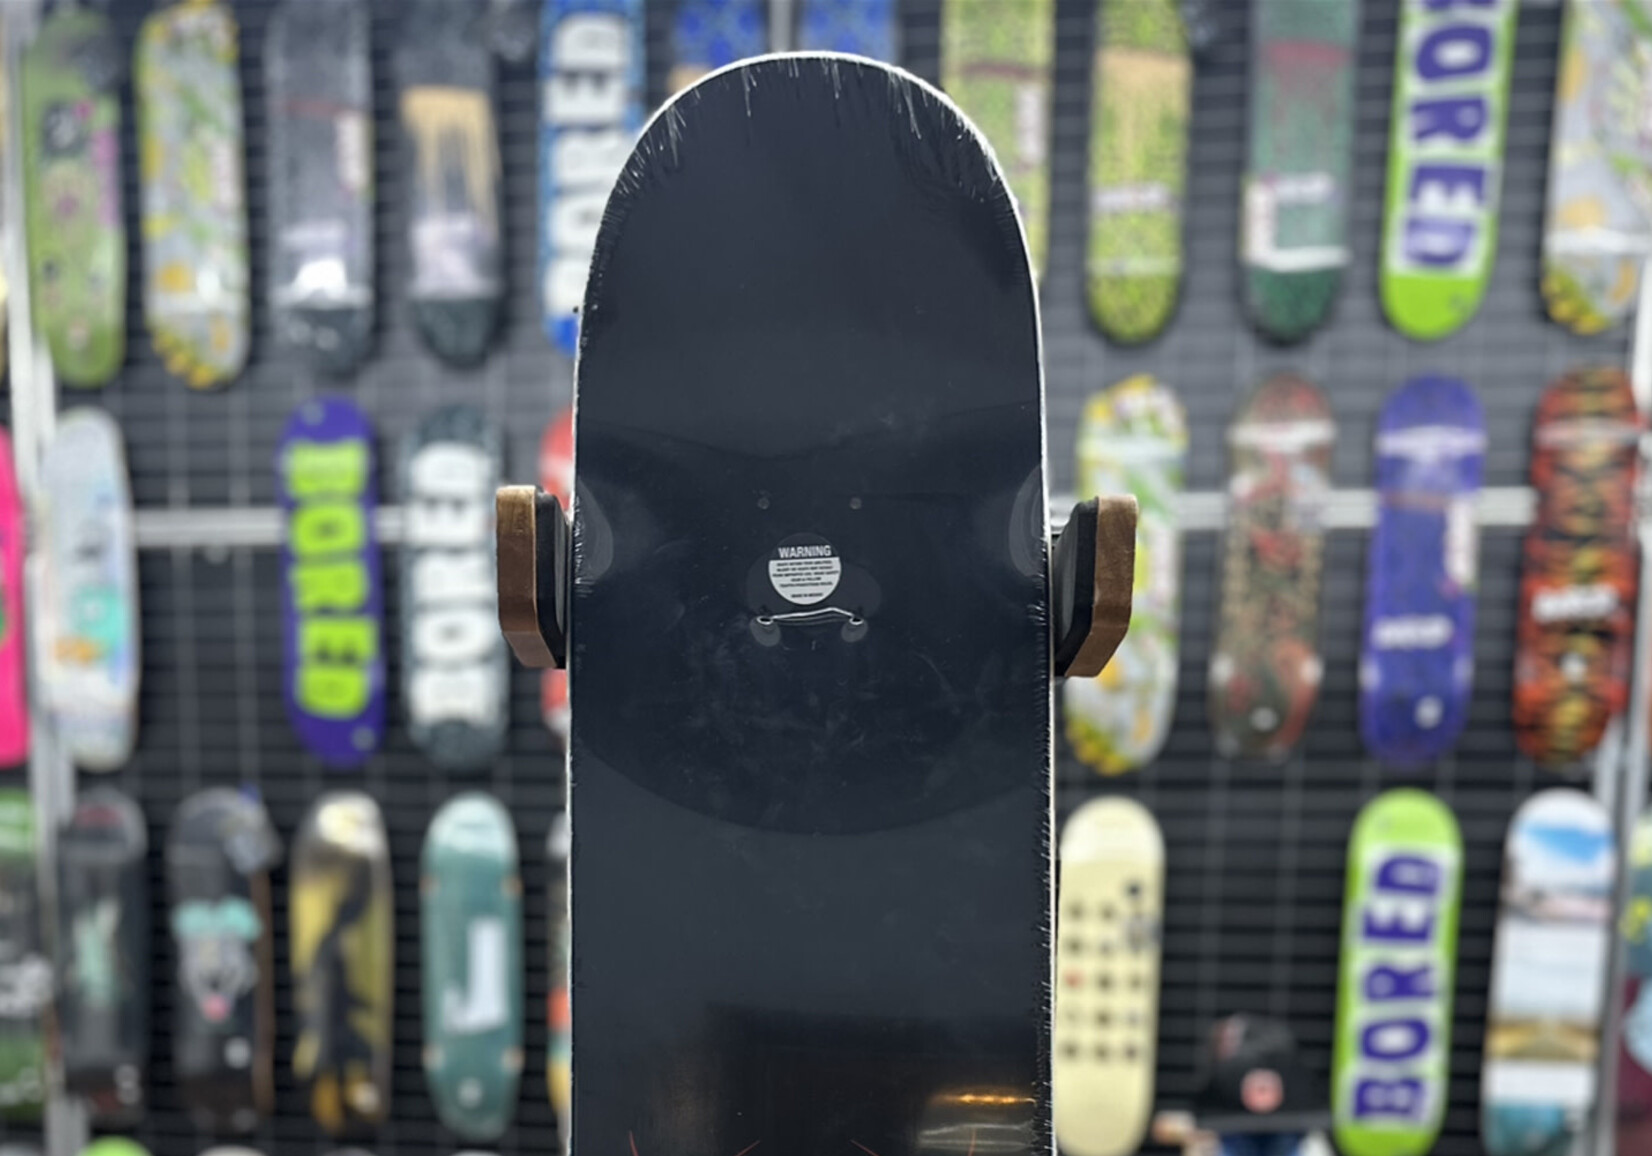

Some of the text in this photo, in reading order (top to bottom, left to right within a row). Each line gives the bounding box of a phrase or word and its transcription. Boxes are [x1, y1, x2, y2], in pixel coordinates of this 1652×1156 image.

[1408, 0, 1496, 265] ORED
[287, 437, 378, 718] BORED
[778, 545, 831, 558] WARNING
[1355, 856, 1440, 1120] BORED
